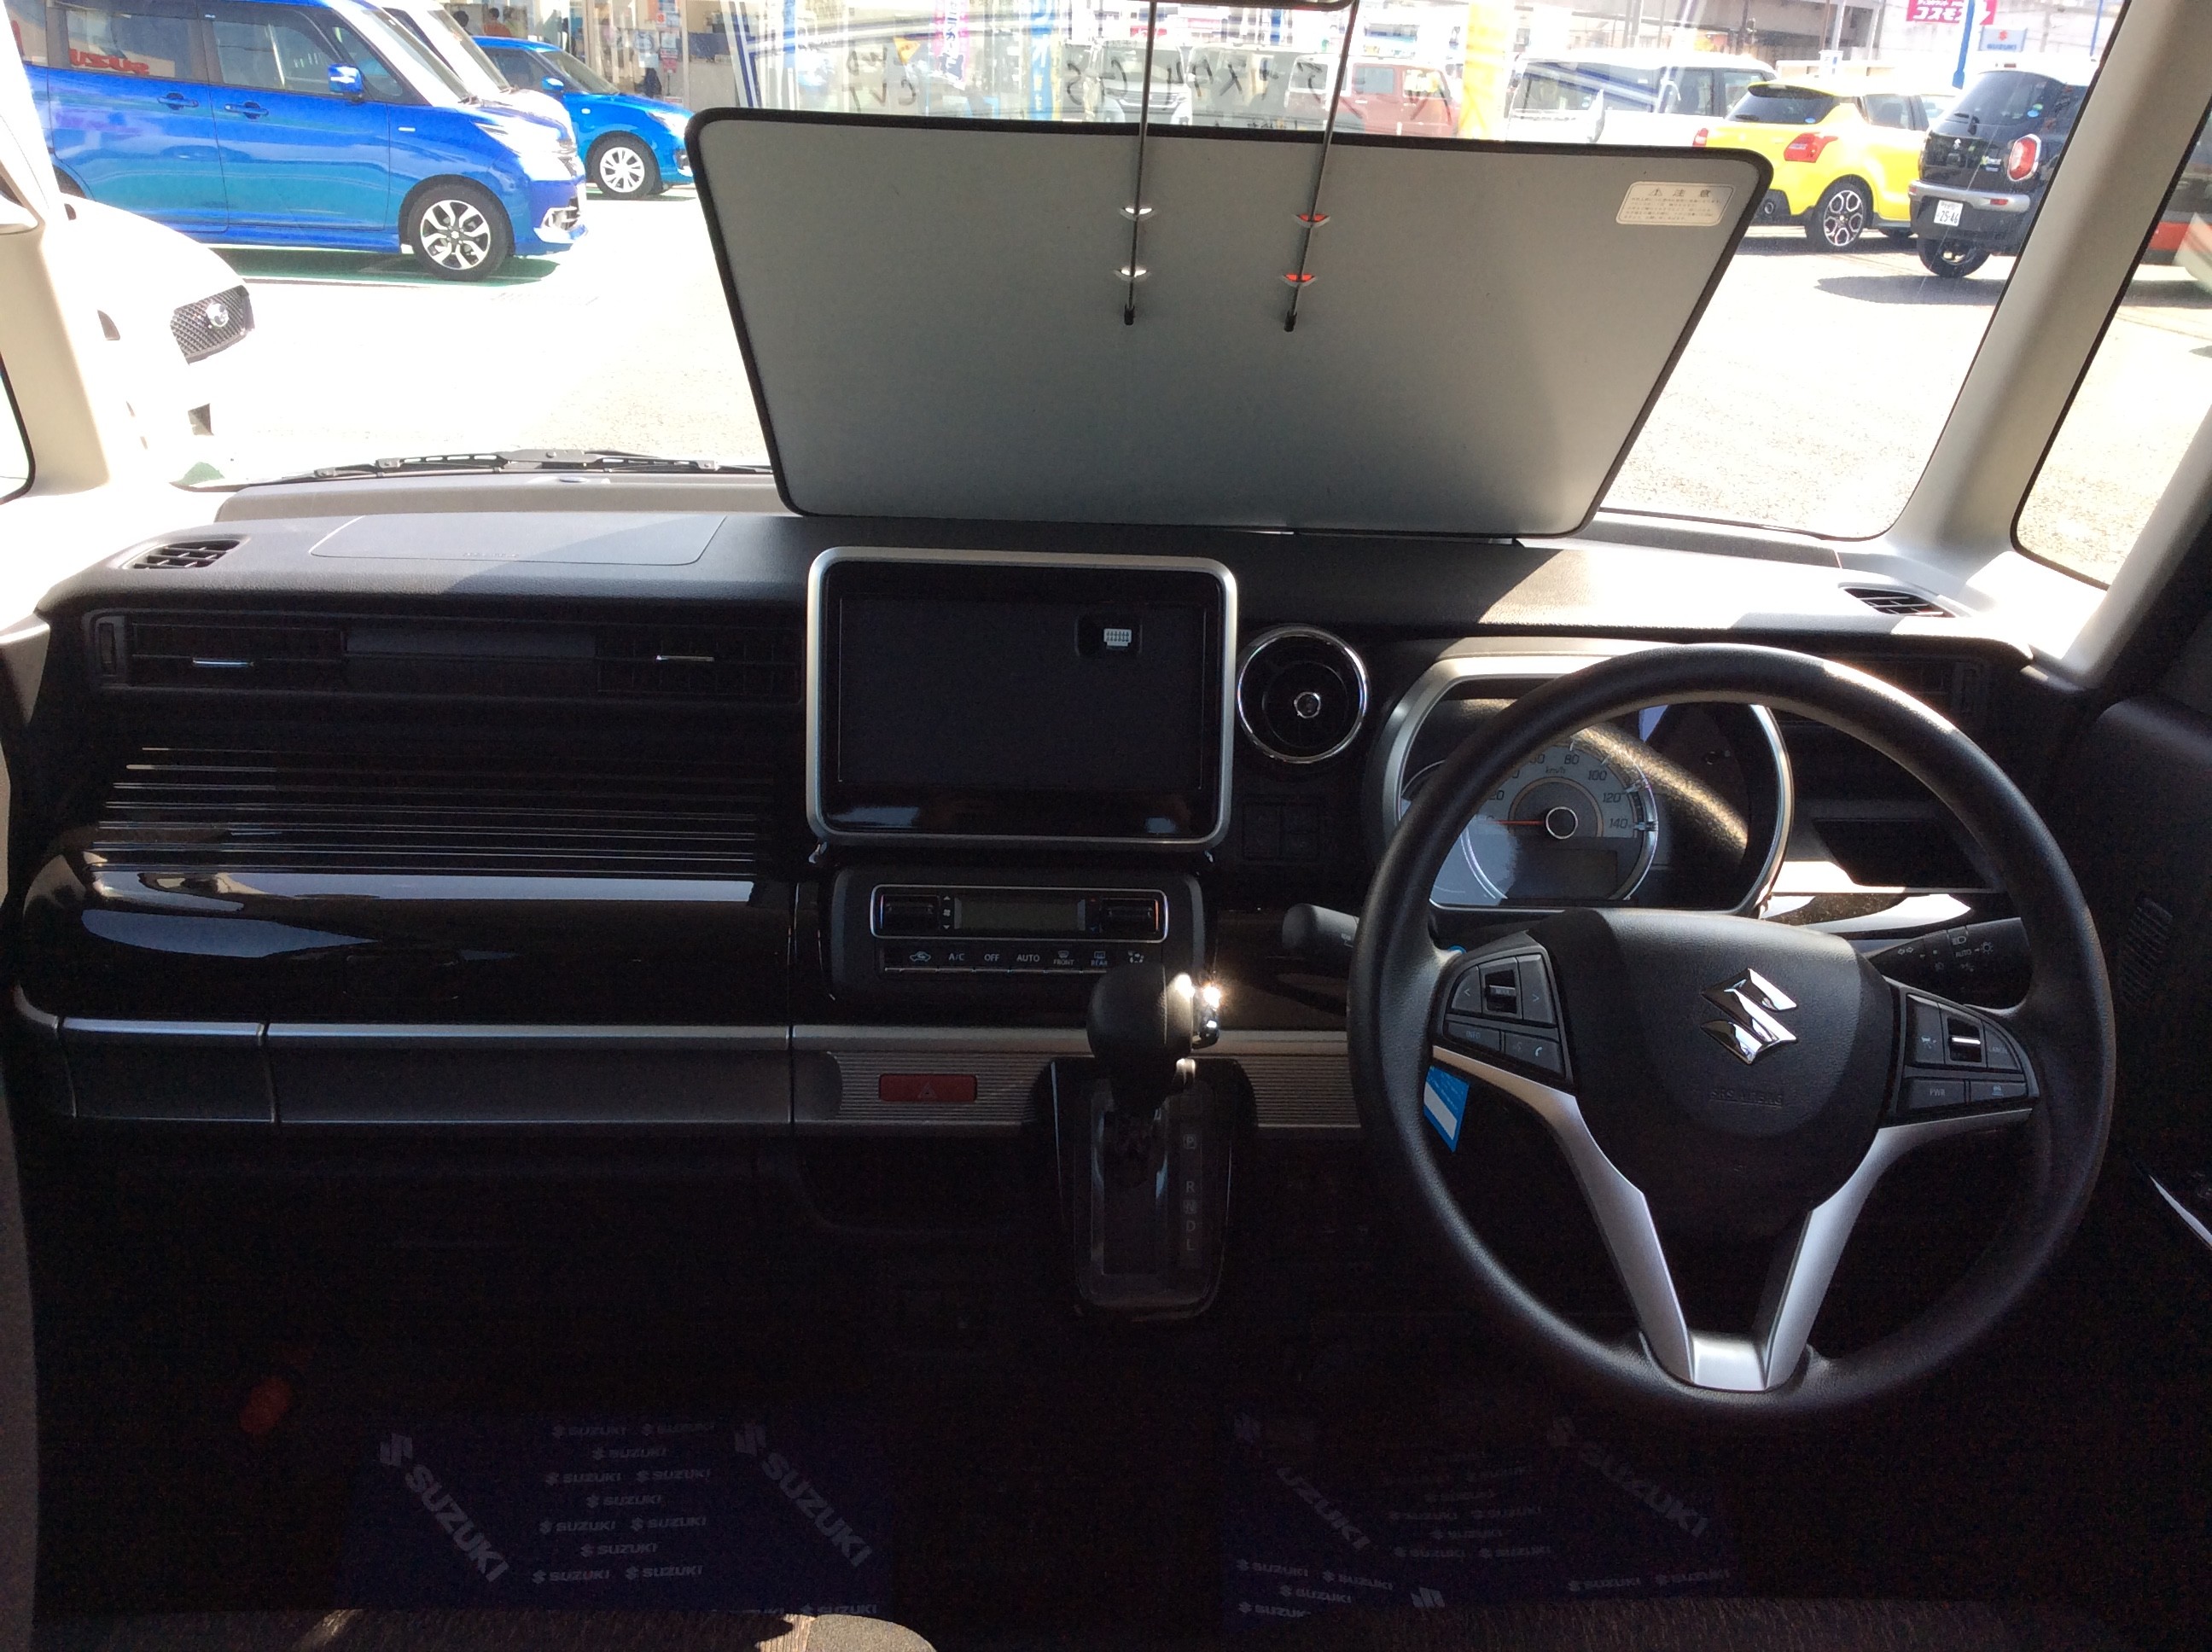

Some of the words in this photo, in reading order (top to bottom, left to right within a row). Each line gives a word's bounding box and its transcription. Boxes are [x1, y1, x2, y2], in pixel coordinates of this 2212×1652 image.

[1563, 754, 1580, 765] 80
[1587, 770, 1608, 782] 100
[1603, 793, 1621, 803] 120
[1610, 818, 1628, 829] 140
[948, 952, 965, 962] A/C
[983, 953, 1000, 963] OFF
[1016, 953, 1040, 963] AUTO
[1930, 1087, 1946, 1096] PWR
[563, 1473, 621, 1483] SUZUKI
[652, 1469, 711, 1480] SUZUKI
[603, 1494, 662, 1506] SUZUKI
[760, 1451, 872, 1568] SUZUKI
[1277, 1467, 1371, 1550] UZUKI
[405, 1464, 509, 1582] SUZUKI
[556, 1521, 615, 1532] SUZUKI
[647, 1516, 707, 1527] SUZUKI
[597, 1543, 657, 1555] SUZUKI
[549, 1569, 610, 1581] SUZUKI
[642, 1565, 703, 1577] SUZUKI
